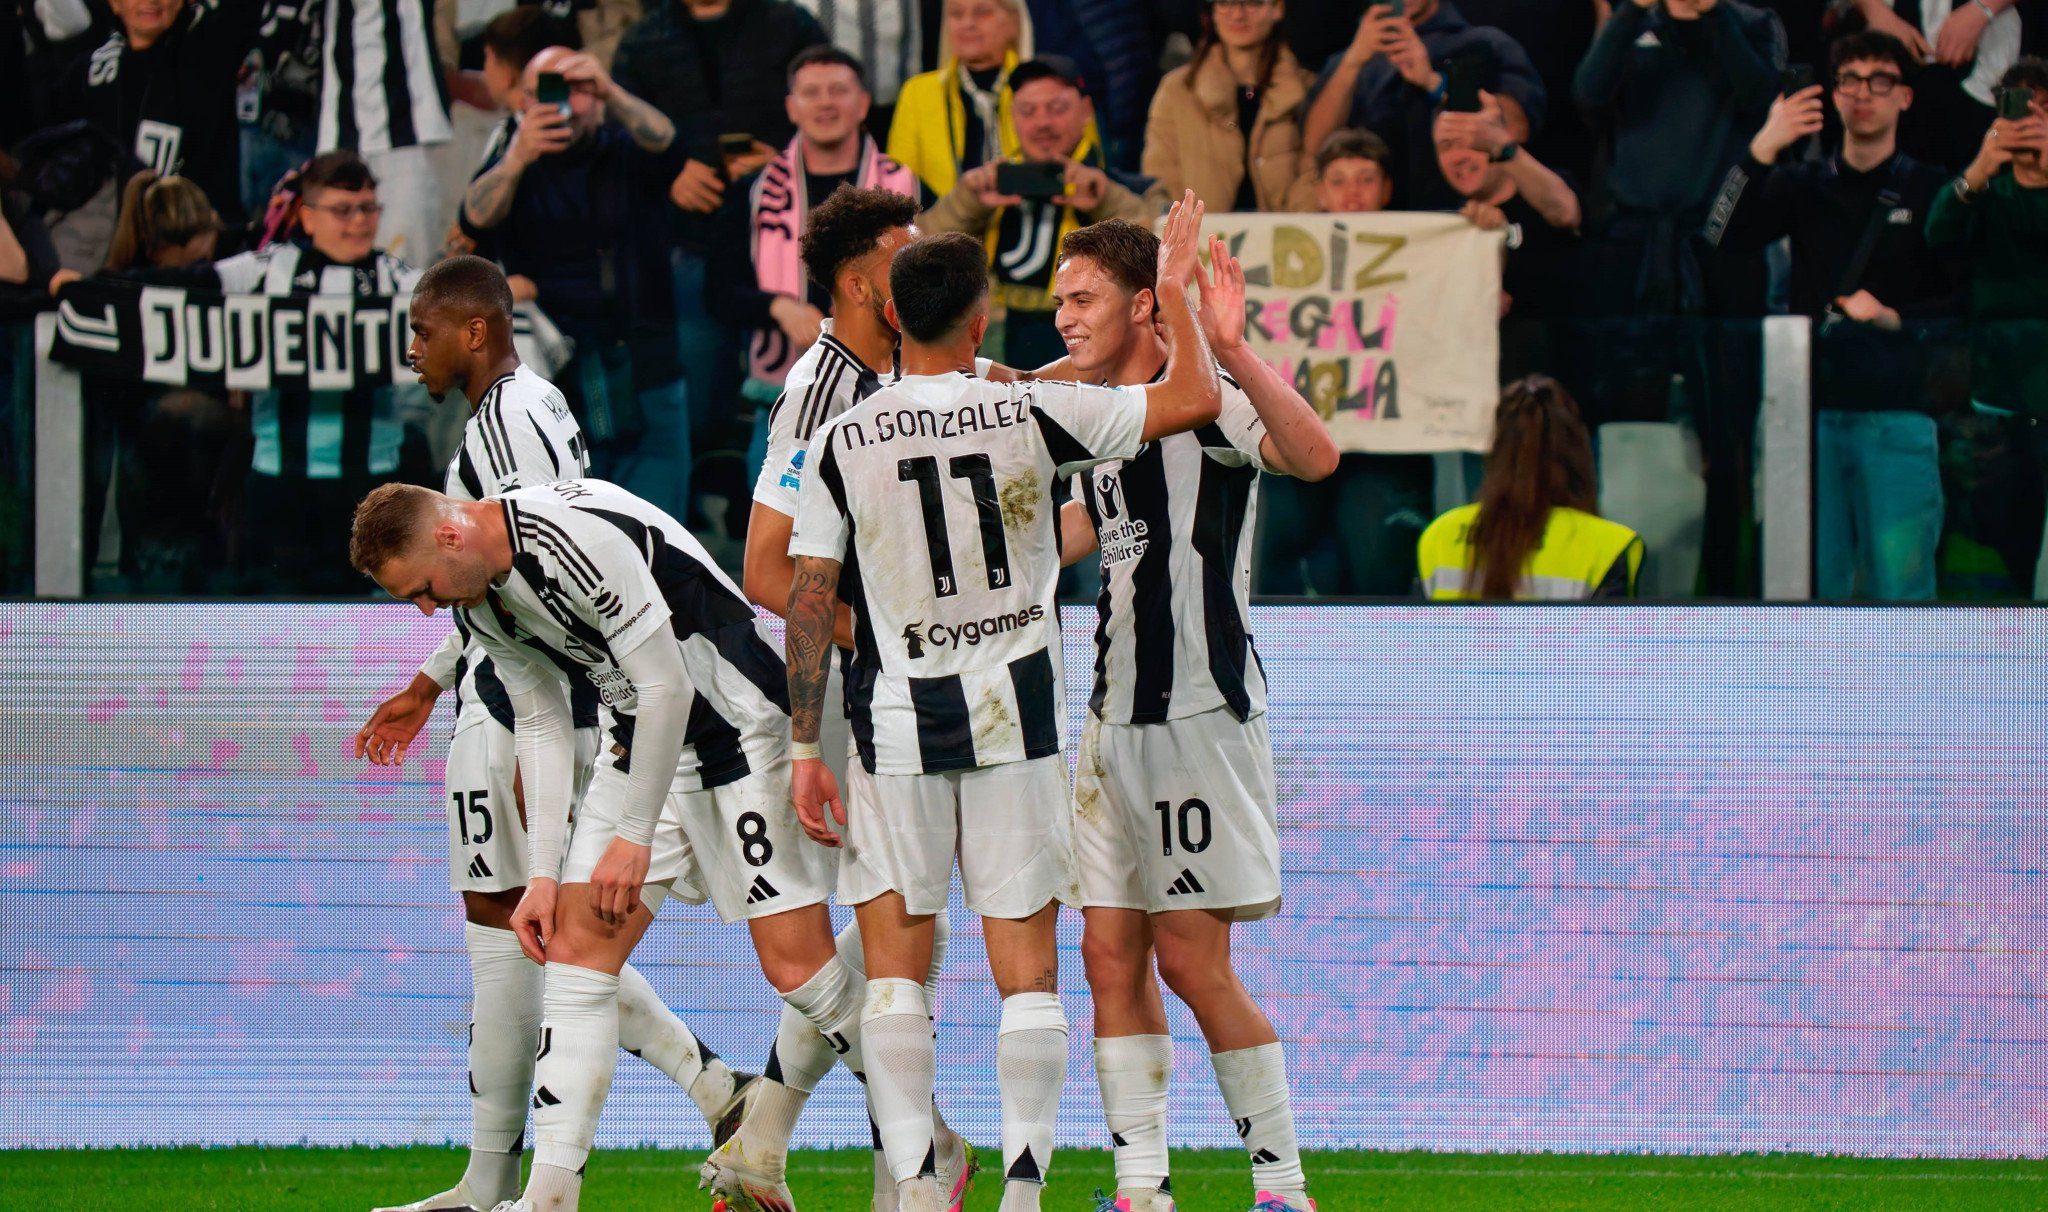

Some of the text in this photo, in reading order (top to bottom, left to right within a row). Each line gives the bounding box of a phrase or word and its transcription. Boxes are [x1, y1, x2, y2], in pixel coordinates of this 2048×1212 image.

[897, 453, 1012, 598] 11
[1120, 520, 1146, 539] the
[928, 604, 1044, 650] Cygames
[587, 666, 627, 686] Save th
[453, 790, 493, 845] 15
[736, 811, 773, 867] 8
[1155, 798, 1212, 856] 10
